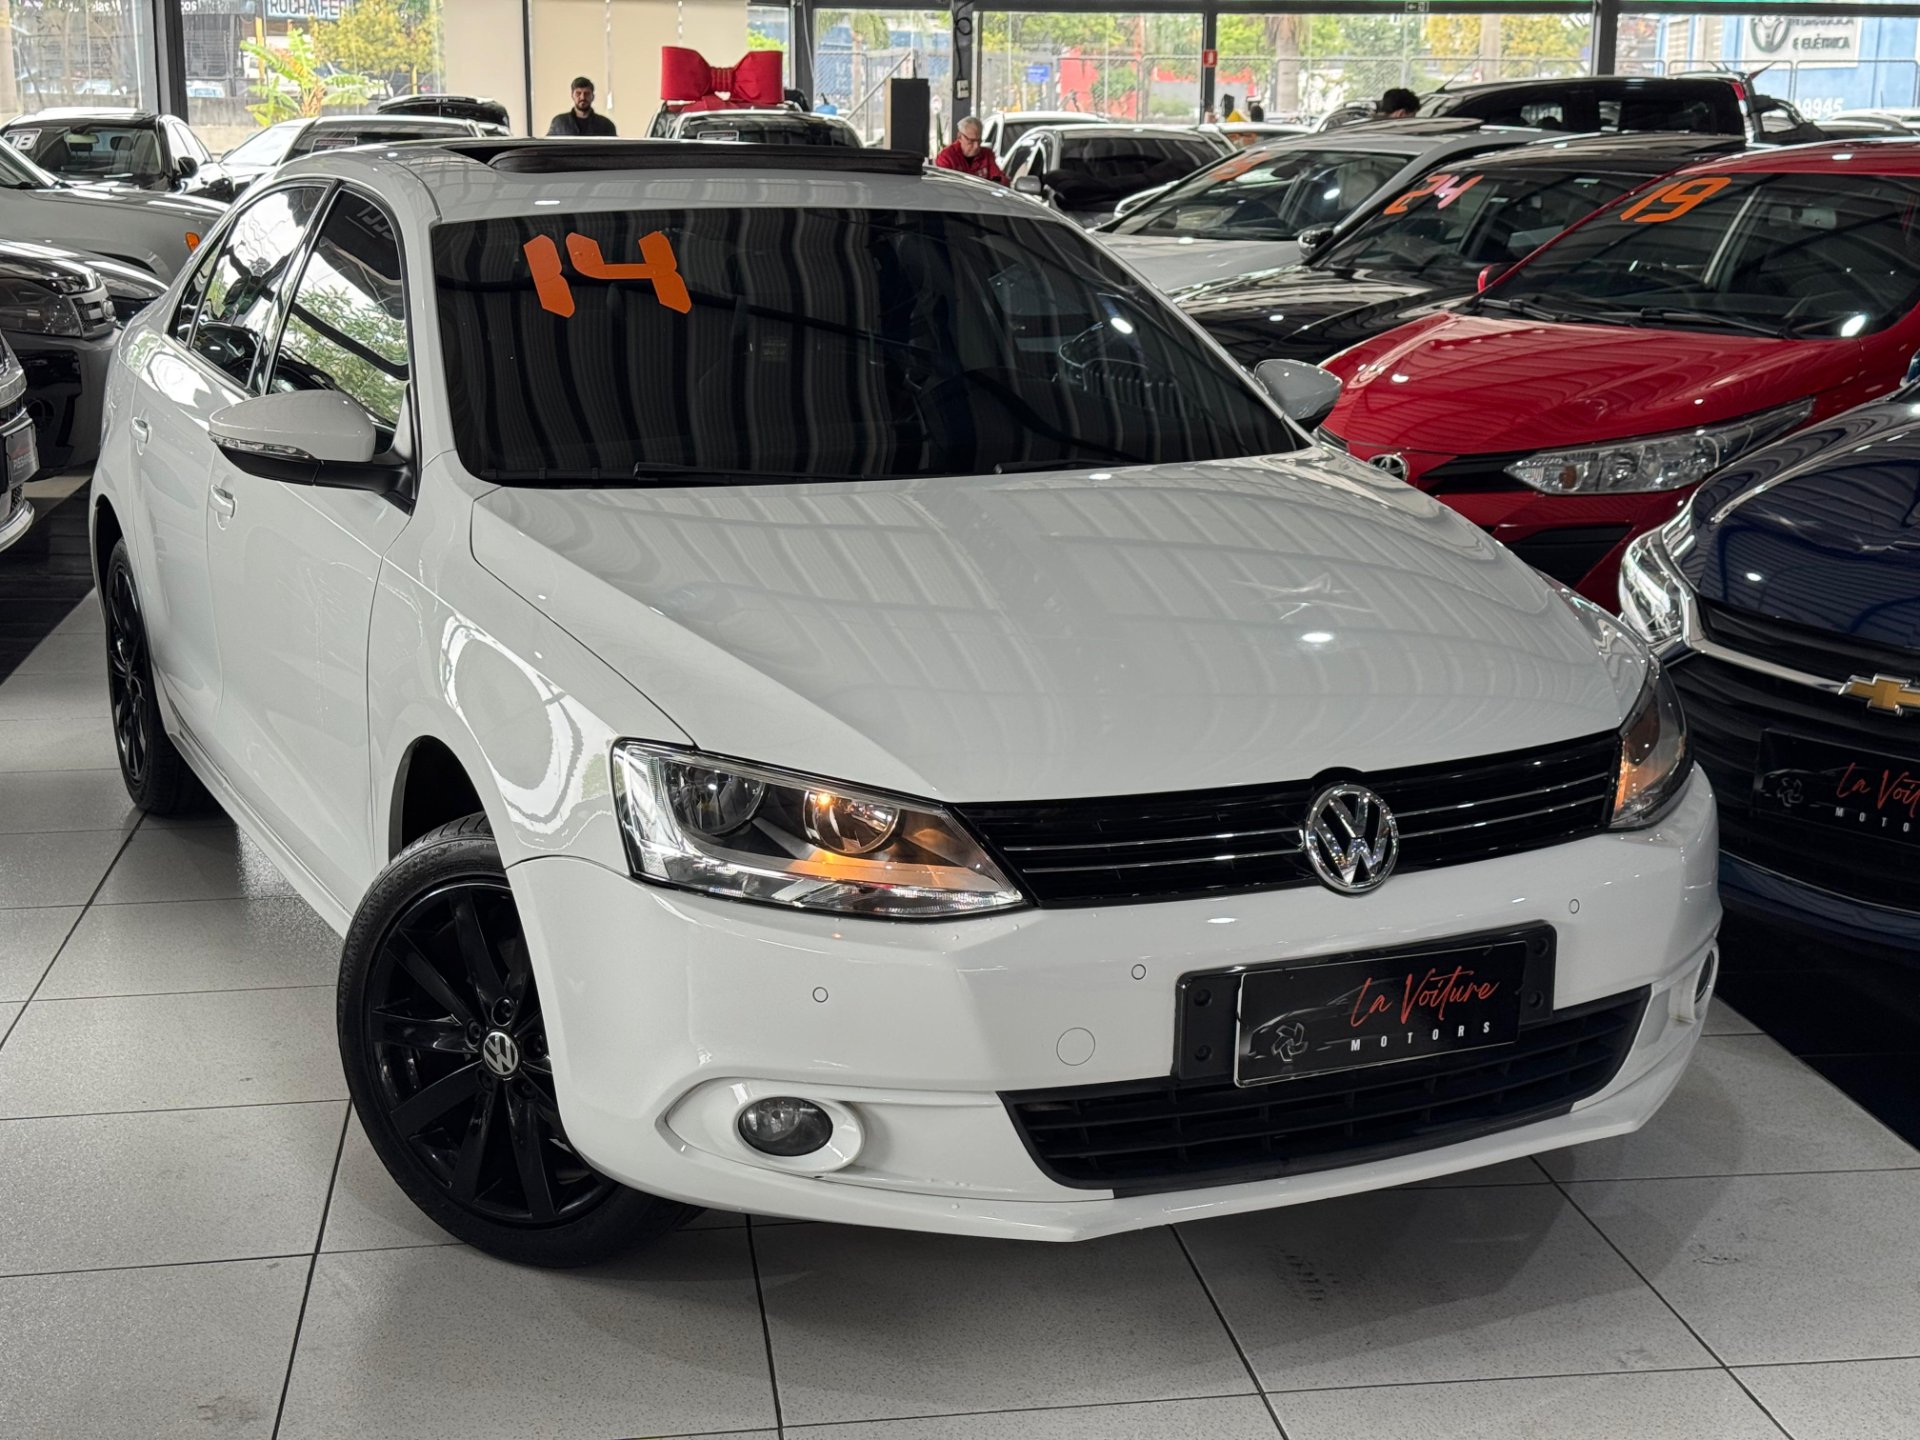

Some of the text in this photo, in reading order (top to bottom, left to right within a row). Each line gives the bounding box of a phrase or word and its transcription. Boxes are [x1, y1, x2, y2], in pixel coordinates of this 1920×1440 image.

[1383, 174, 1484, 215] 24
[1620, 177, 1732, 223] 19
[523, 231, 692, 318] 14
[1836, 762, 1872, 798] La
[1350, 965, 1500, 1028] La Voiture
[1350, 1021, 1490, 1052] MOTORS
